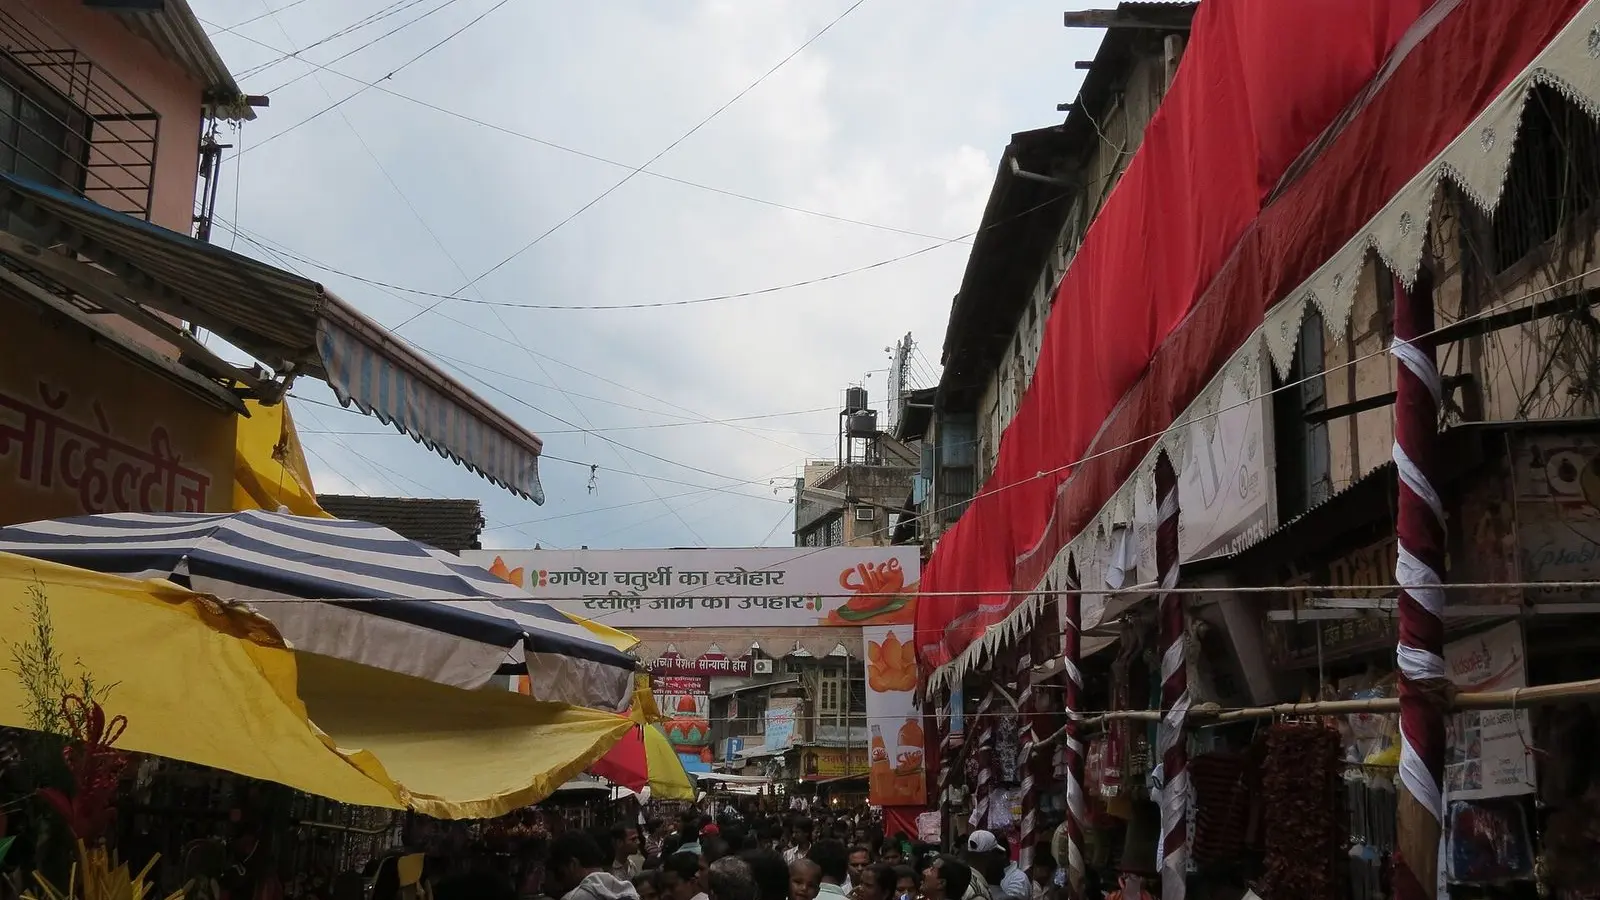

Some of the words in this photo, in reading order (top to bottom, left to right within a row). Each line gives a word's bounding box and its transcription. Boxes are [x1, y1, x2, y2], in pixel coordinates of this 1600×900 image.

[548, 566, 609, 587] गणेश
[613, 566, 673, 591] चतुर्थी
[678, 570, 709, 586] का
[714, 566, 786, 586] त्योहार
[582, 590, 642, 611] रसीले
[648, 594, 694, 610] आम
[700, 595, 731, 610] का
[737, 595, 804, 610] उपहार
[699, 655, 730, 671] सोन्याची
